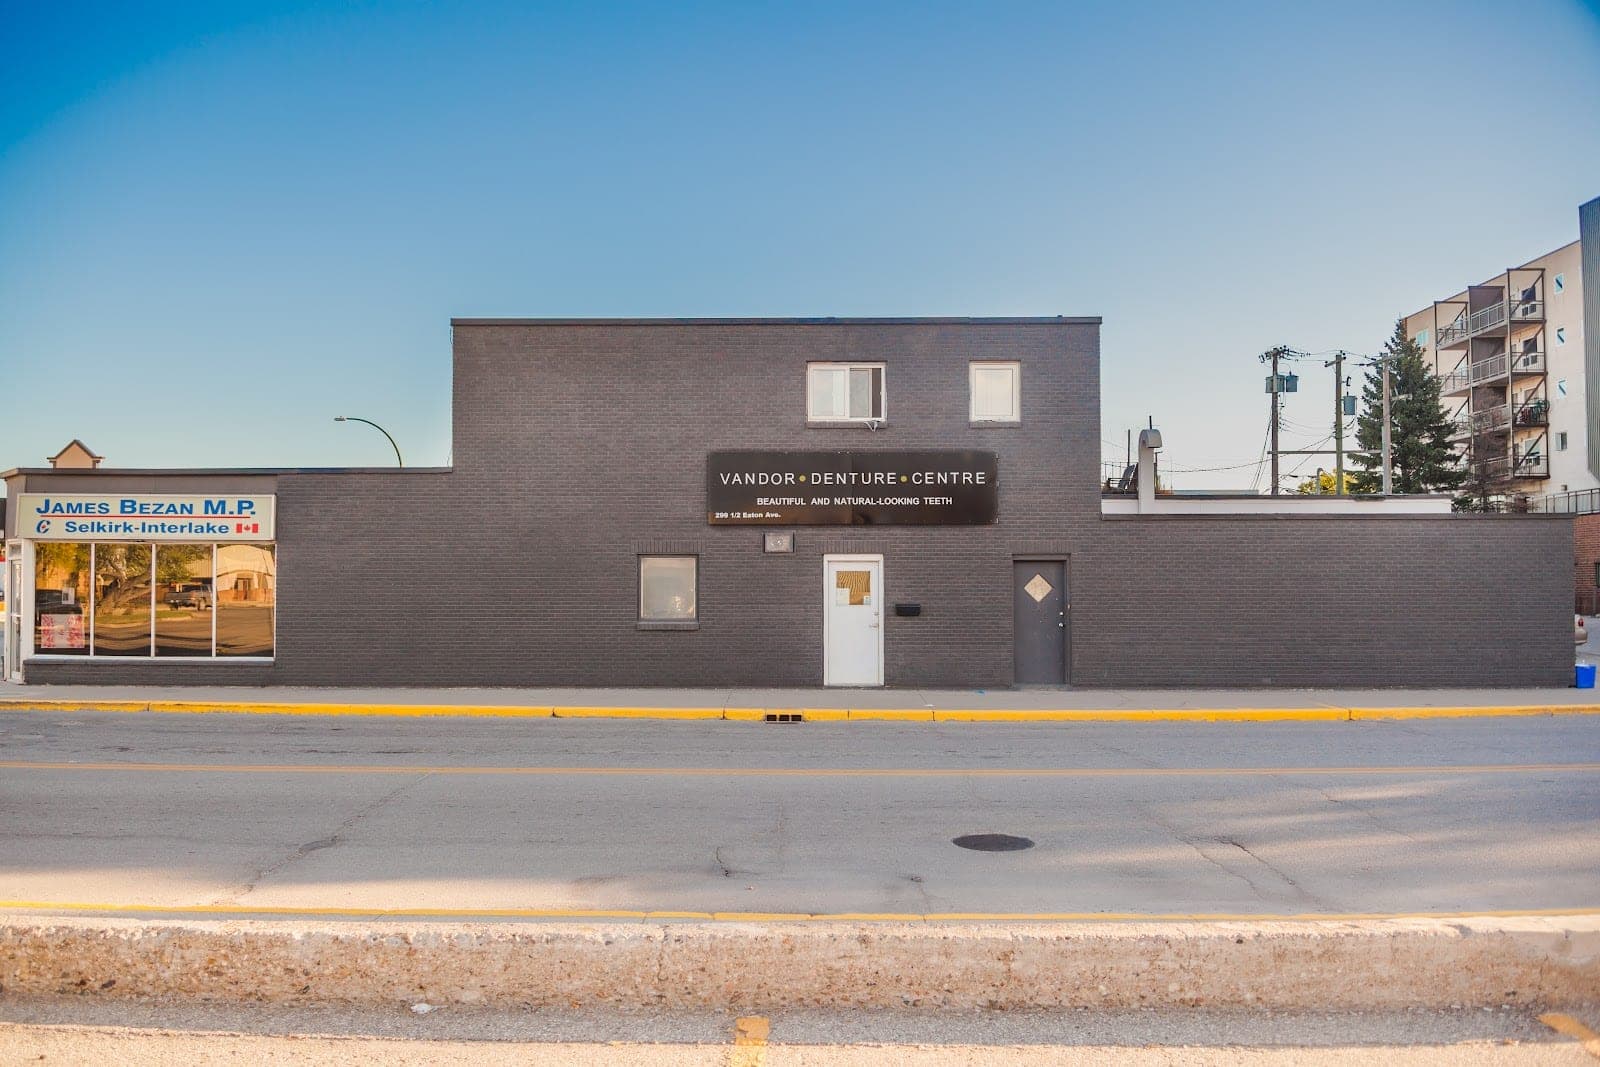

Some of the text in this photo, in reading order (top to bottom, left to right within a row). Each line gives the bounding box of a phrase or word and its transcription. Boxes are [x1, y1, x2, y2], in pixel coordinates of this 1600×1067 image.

[720, 471, 986, 485] VANDOR DENTURE CENTRE
[36, 498, 256, 515] JAMES BEZAN M.P.
[756, 496, 953, 506] BEAUTIFUL AND NATURAL-LOOKING TEETH
[64, 521, 230, 534] Selkirk-Interlake
